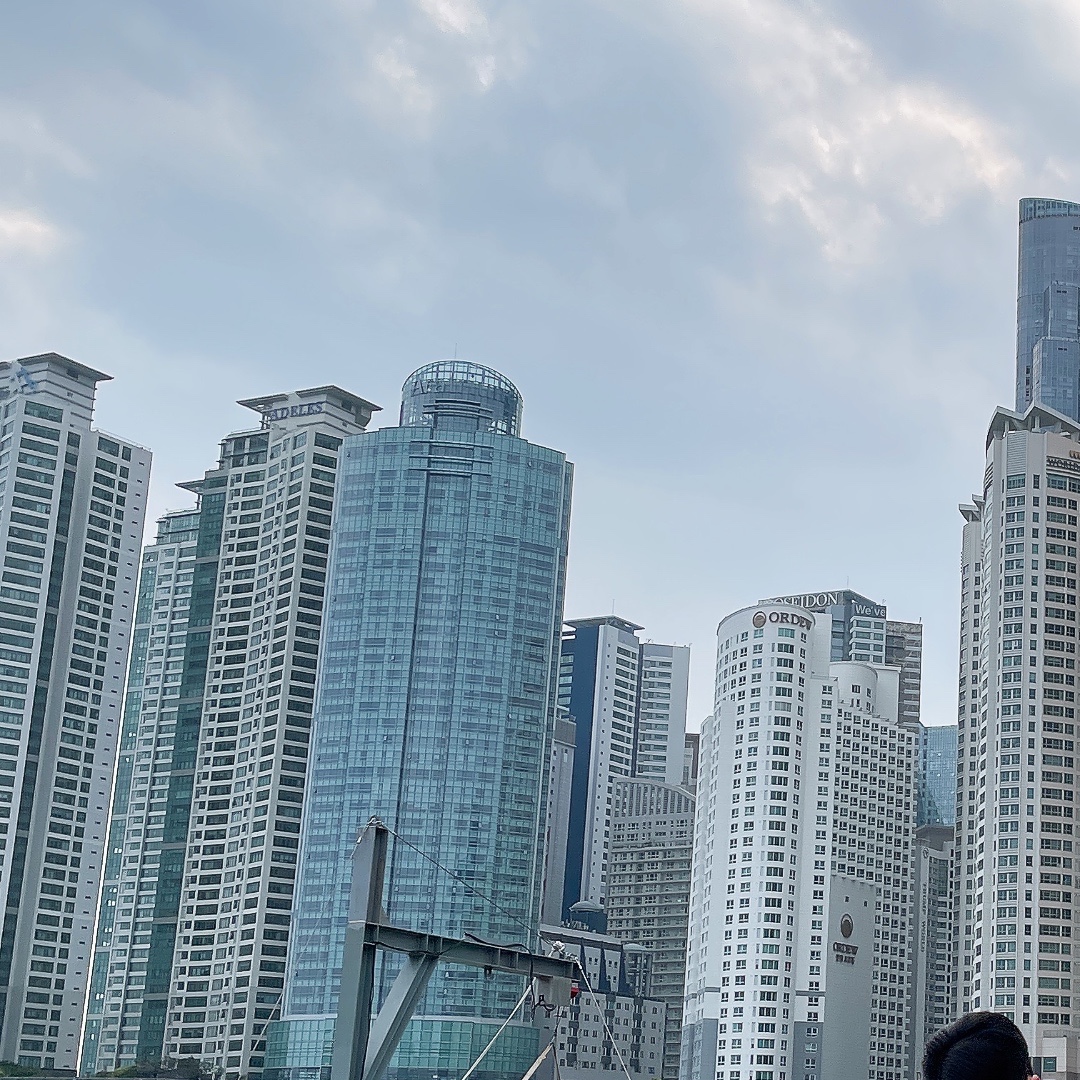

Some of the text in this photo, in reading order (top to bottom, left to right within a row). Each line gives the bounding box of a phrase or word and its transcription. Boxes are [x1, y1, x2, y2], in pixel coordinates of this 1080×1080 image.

[270, 402, 323, 421] ADELES
[772, 591, 840, 609] SEIDON
[855, 603, 886, 617] We've
